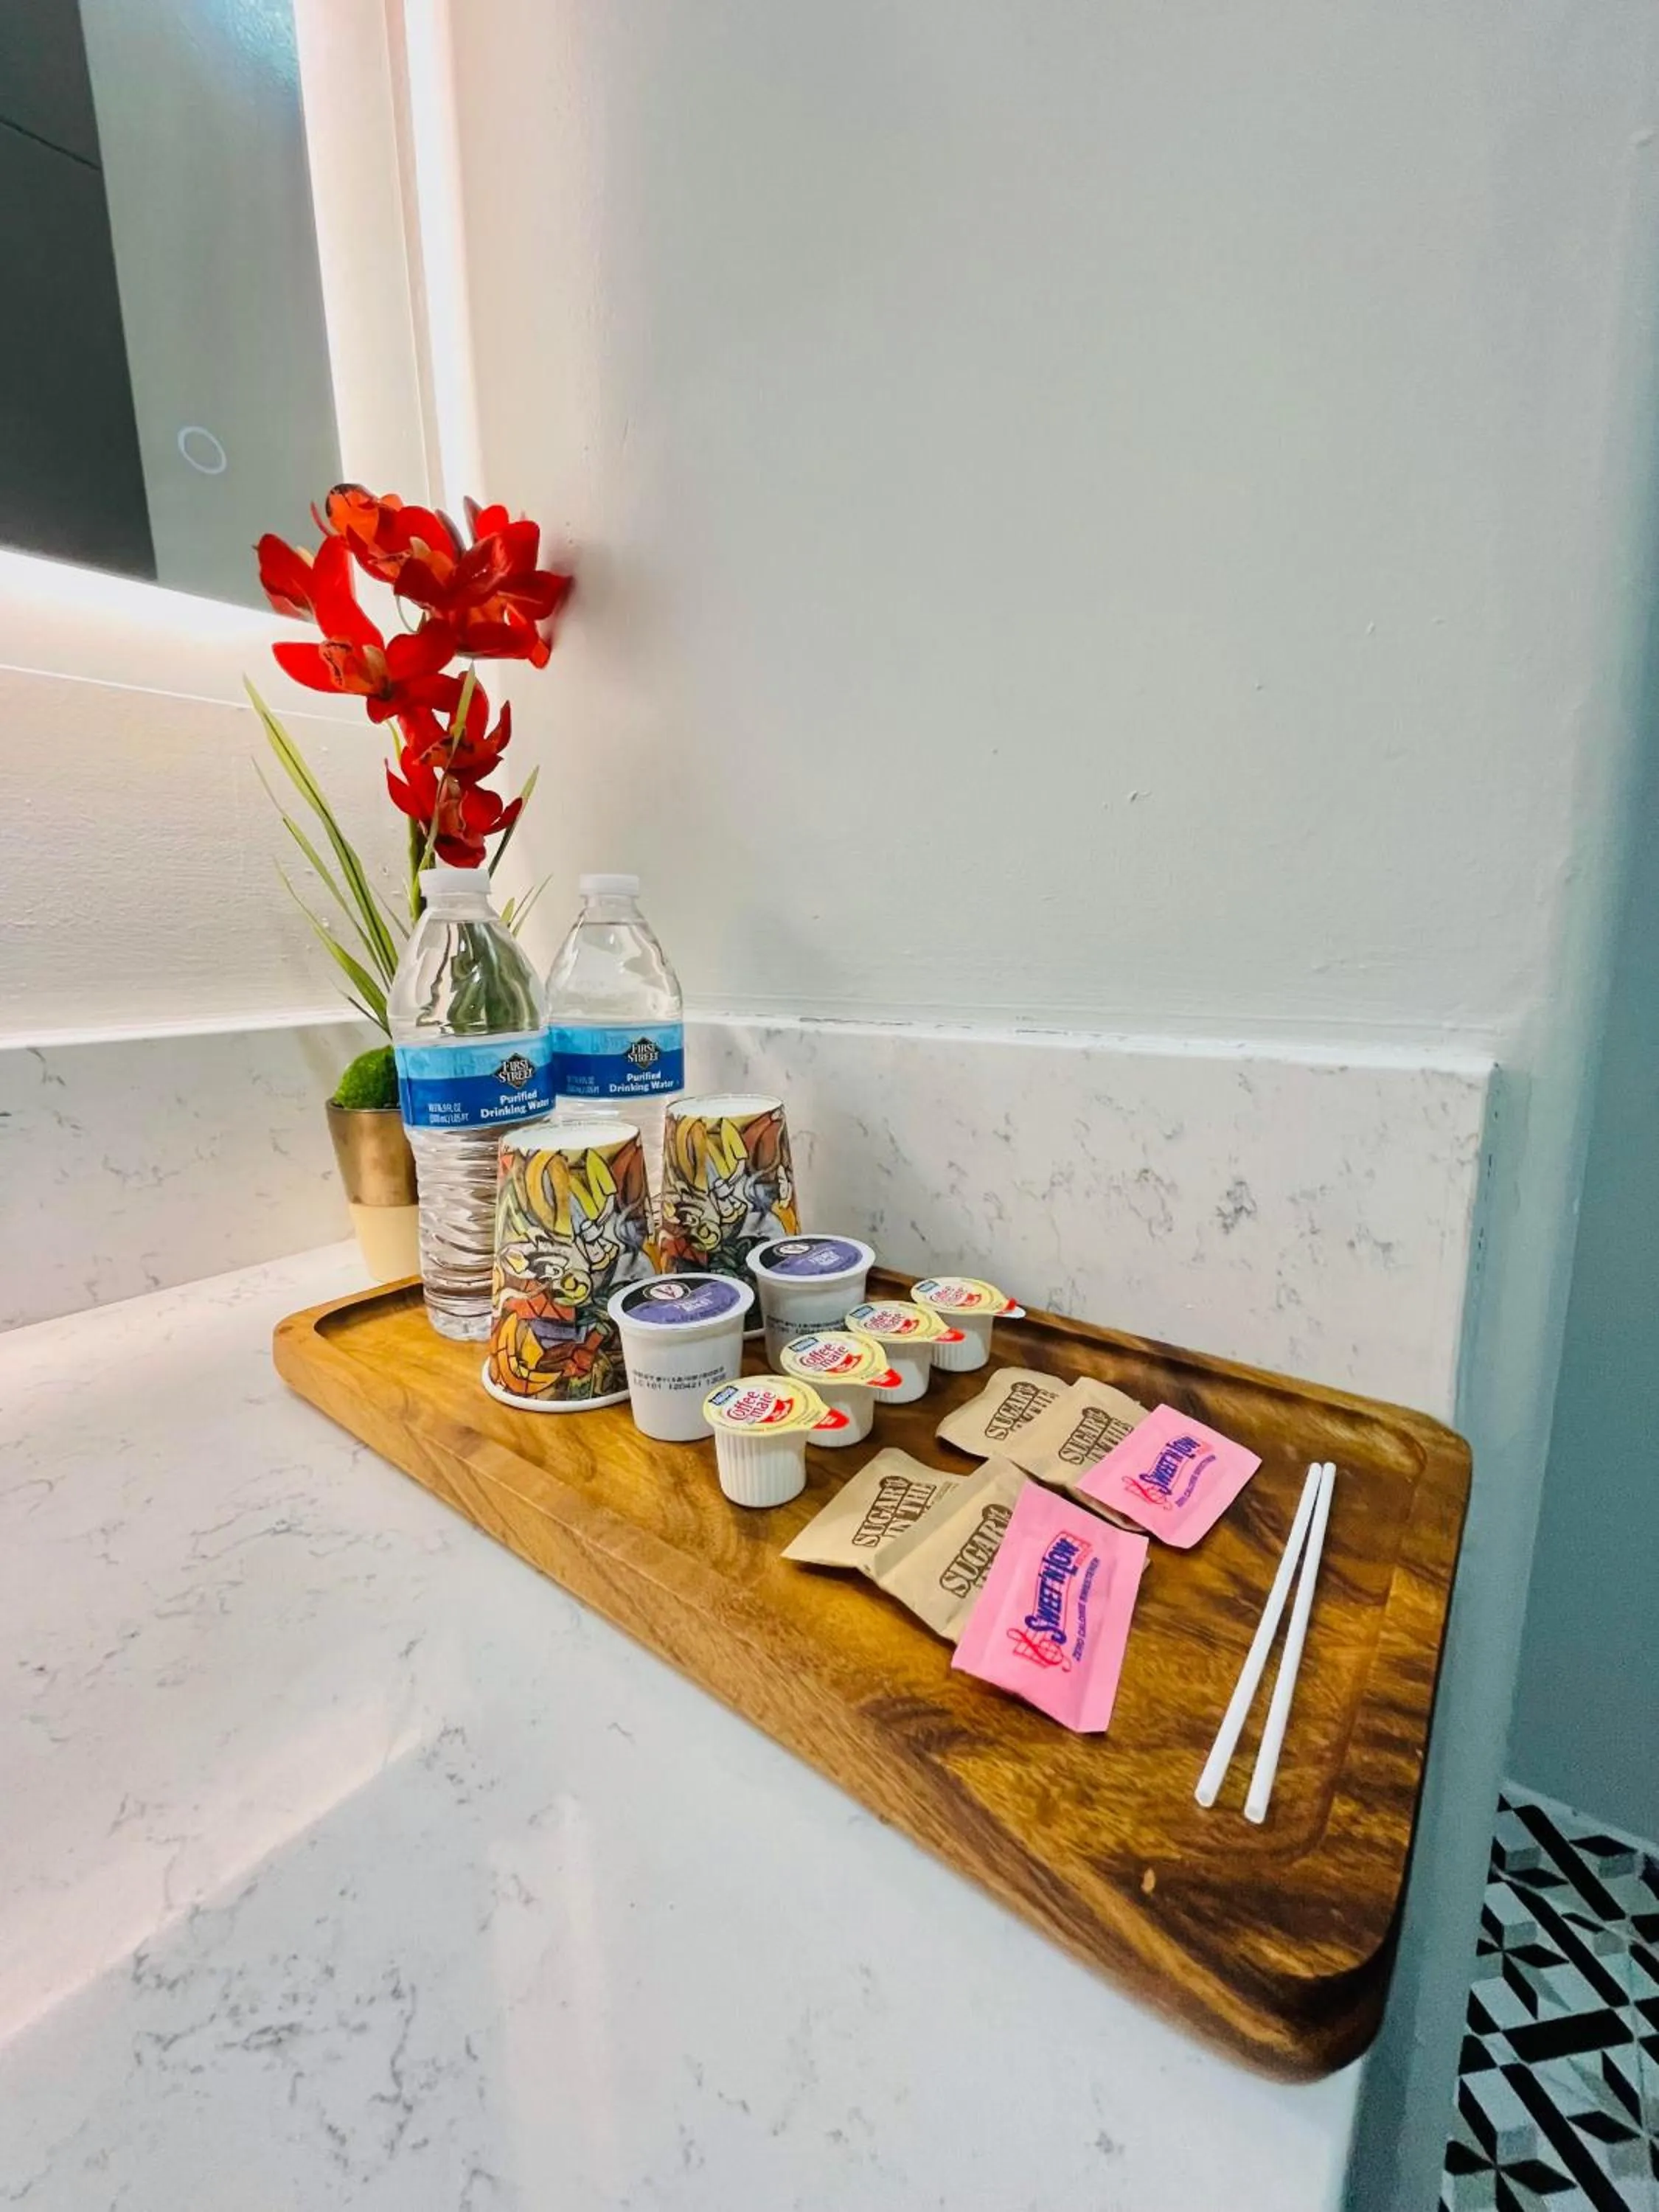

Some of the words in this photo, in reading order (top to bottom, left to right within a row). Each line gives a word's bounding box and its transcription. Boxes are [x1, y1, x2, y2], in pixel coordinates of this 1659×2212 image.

[627, 1052, 659, 1063] STREET
[631, 1043, 655, 1054] FIRST
[498, 1068, 533, 1083] STREET
[503, 1060, 529, 1072] FIRST
[627, 1071, 661, 1082] Purified
[609, 1082, 650, 1093] Drinking
[651, 1079, 675, 1089] Water
[500, 1090, 538, 1105] Purified
[481, 1105, 526, 1119] Drinking
[528, 1098, 549, 1110] Water
[799, 1343, 835, 1368] Coffee
[819, 1346, 849, 1367] mate
[726, 1391, 760, 1421] Coffee
[750, 1391, 776, 1417] mate
[986, 1383, 1036, 1439] SUGAR
[1059, 1409, 1109, 1472] SUGAR
[853, 1478, 908, 1546] SUGAR
[941, 1512, 1009, 1597] SUGAR
